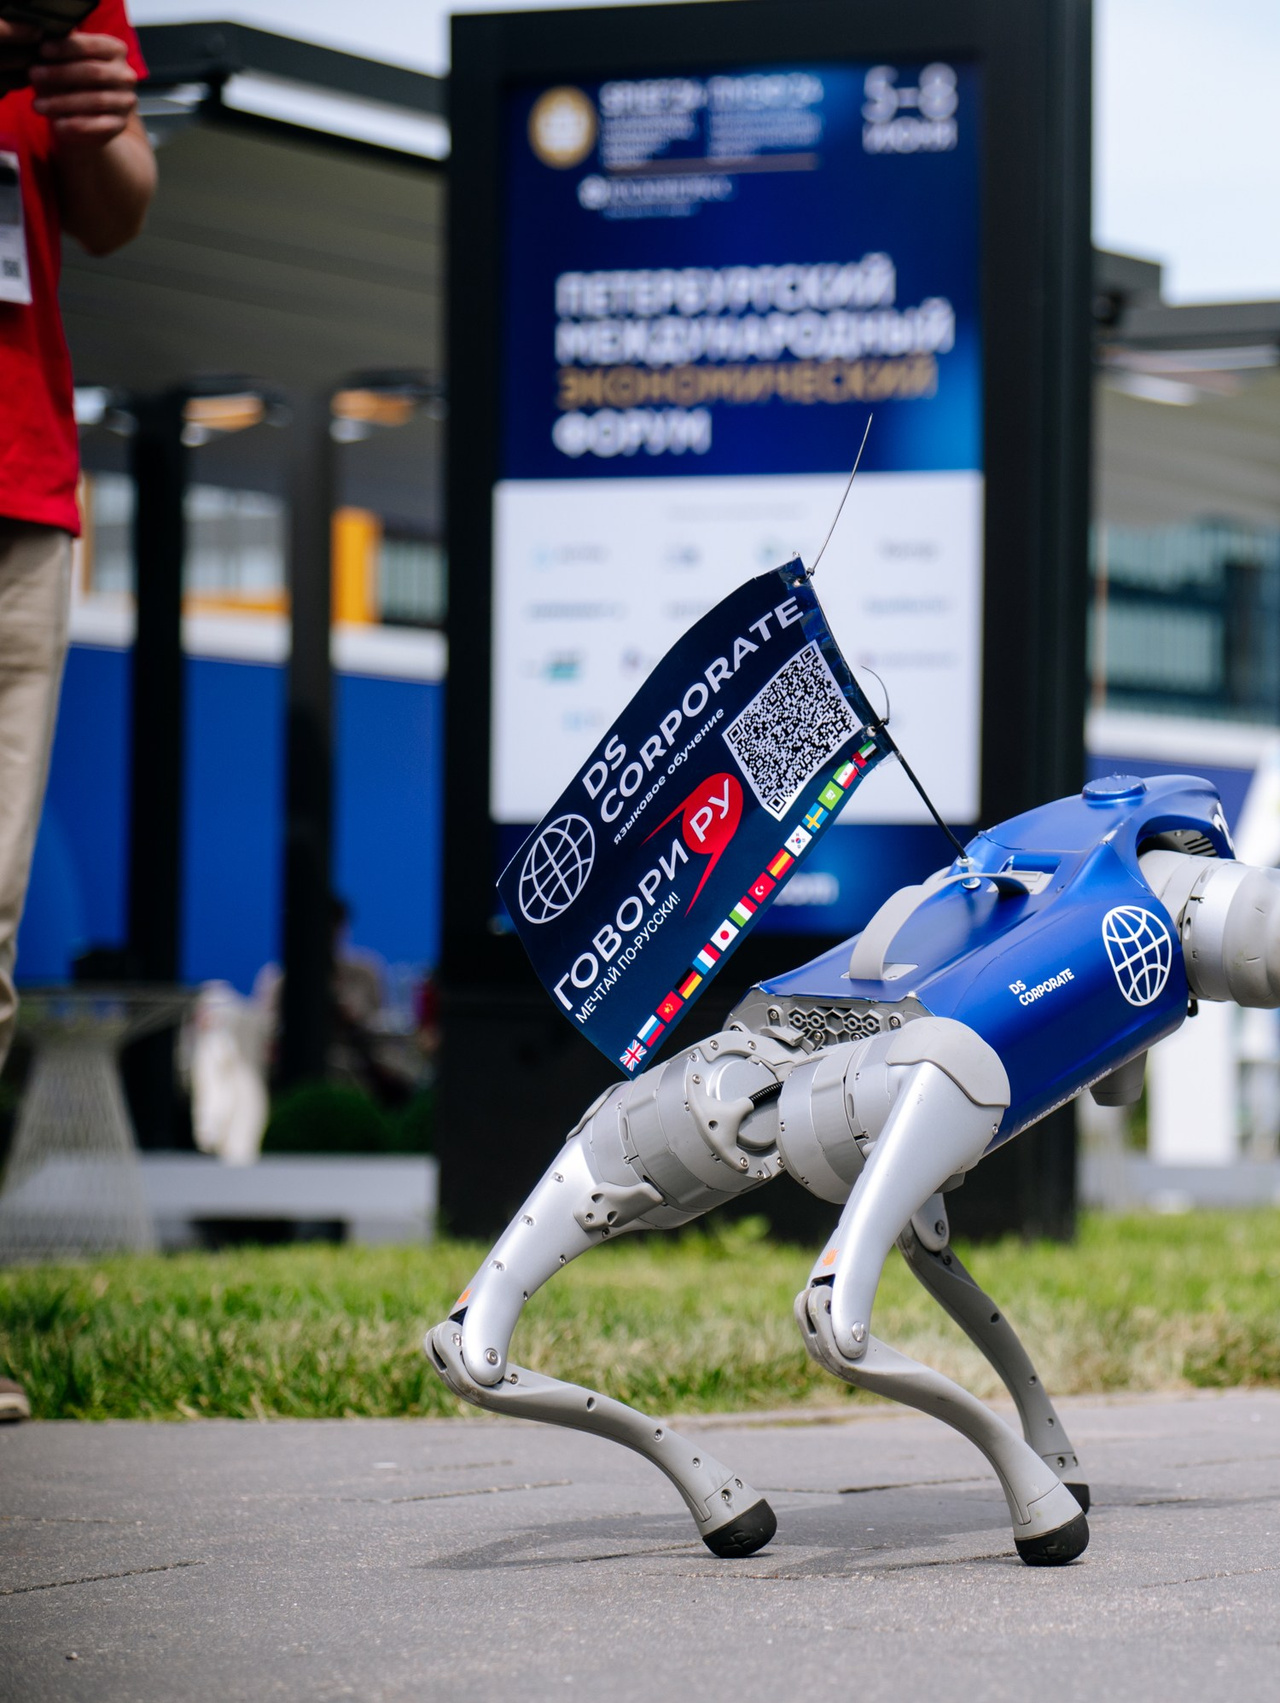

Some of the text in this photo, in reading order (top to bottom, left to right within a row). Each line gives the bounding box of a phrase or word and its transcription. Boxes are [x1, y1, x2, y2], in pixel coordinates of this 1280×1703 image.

[582, 734, 627, 800] DS
[600, 596, 804, 823] CORPORATE
[613, 708, 725, 845] языковое обучение
[553, 838, 689, 1011] ГОВОРИ
[575, 891, 681, 1024] МЕЧТАЙ ПО-РУССКИ!
[1008, 980, 1026, 995] DS
[1018, 967, 1075, 1006] CORPORATE
